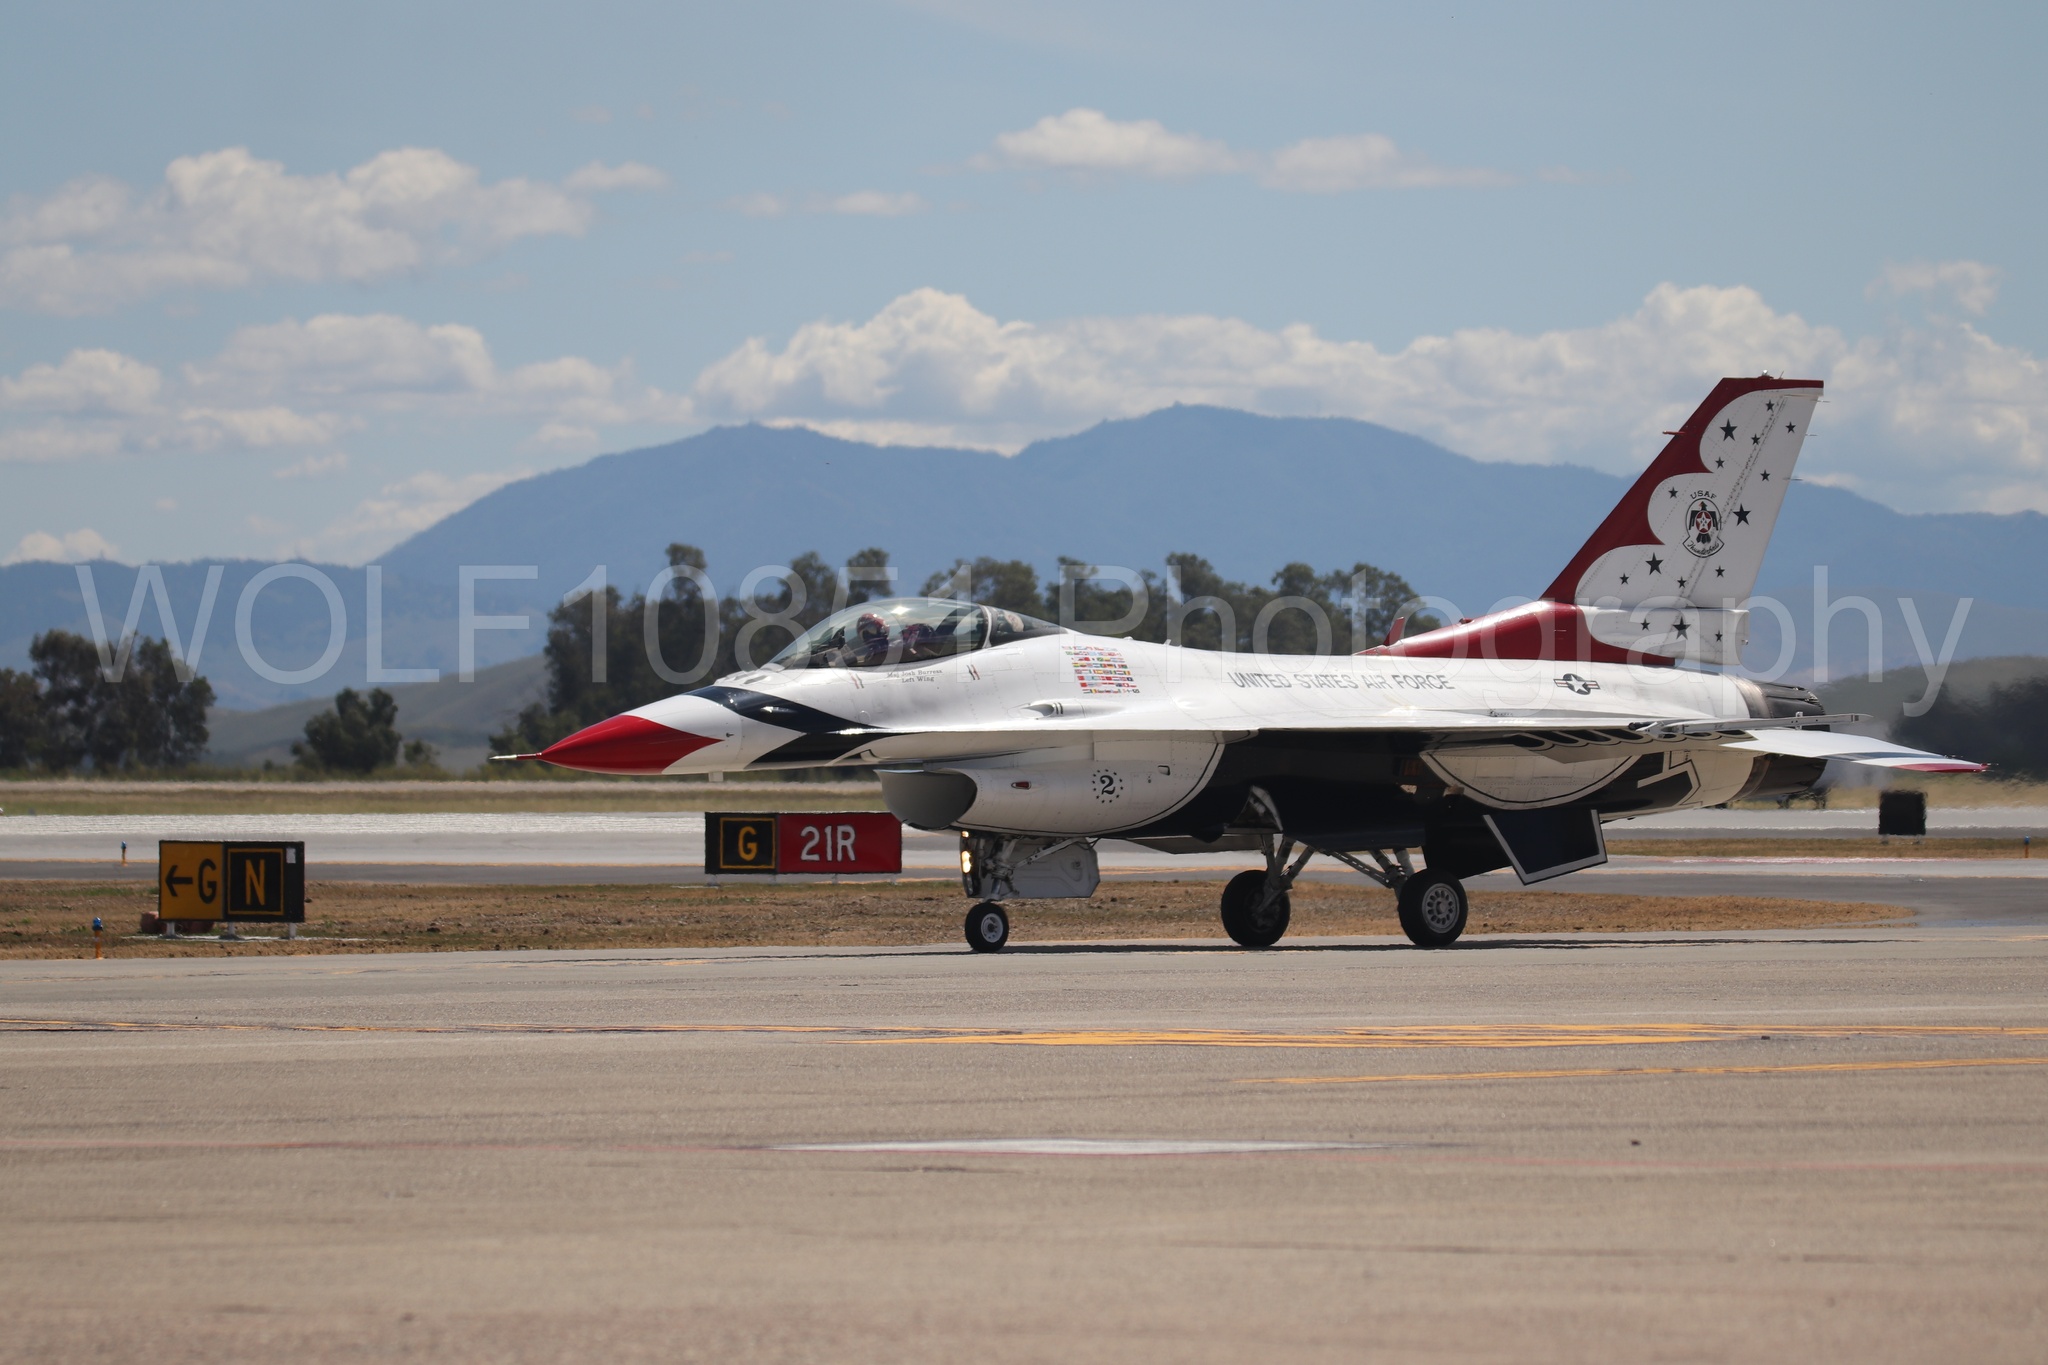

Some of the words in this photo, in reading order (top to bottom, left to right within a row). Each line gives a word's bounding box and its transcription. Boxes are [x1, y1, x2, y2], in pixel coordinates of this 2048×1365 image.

[1690, 490, 1717, 499] USAF
[1227, 672, 1292, 688] UNITED
[1294, 674, 1359, 689] STATES
[1361, 674, 1393, 689] AIR
[1392, 674, 1456, 689] FORCE
[1101, 775, 1115, 795] 2
[738, 826, 758, 861] G
[800, 824, 856, 862] 21R
[198, 858, 217, 904] G
[245, 859, 266, 906] N
